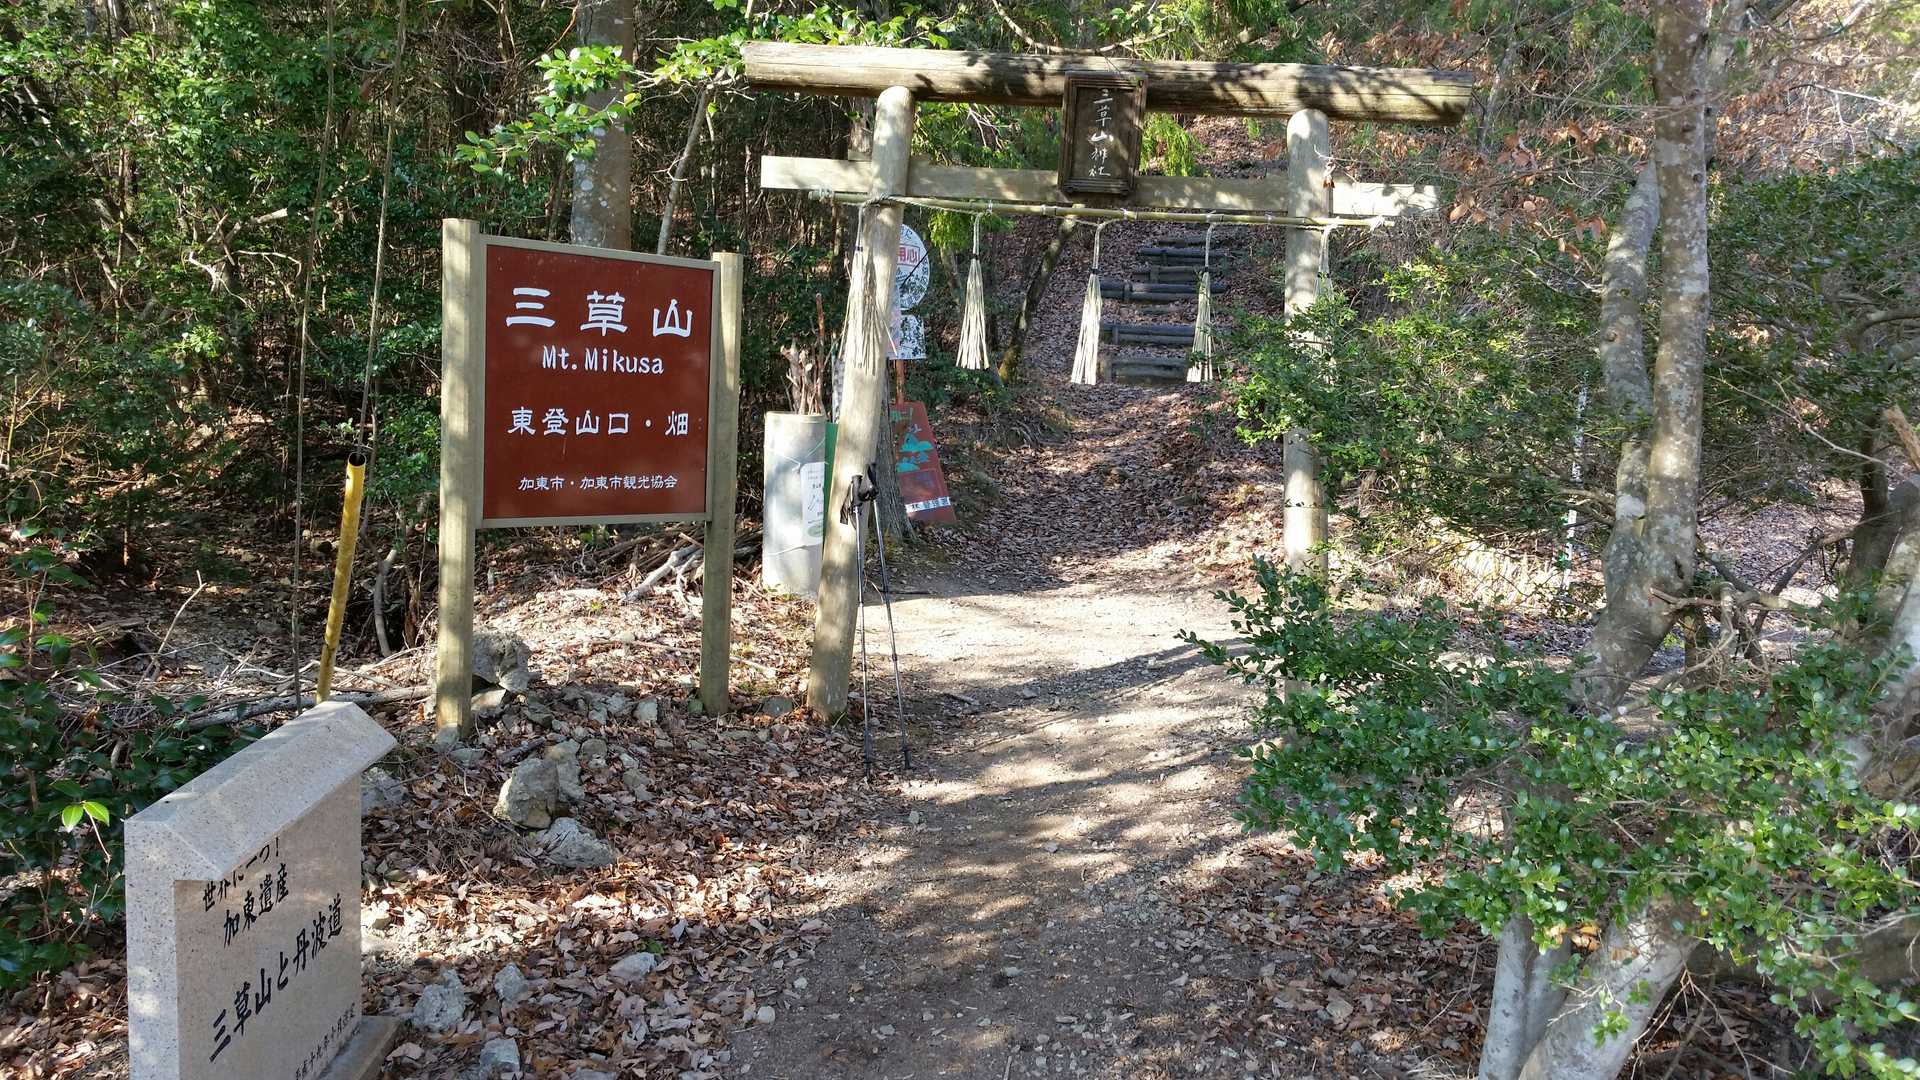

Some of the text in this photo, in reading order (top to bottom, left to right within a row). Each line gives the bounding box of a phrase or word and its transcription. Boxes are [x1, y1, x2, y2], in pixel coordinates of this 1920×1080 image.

[505, 287, 693, 338] 三草山
[507, 406, 689, 437] 東登山口・畑
[517, 475, 679, 491] 加東市・加東市観光協会
[223, 862, 290, 949] 加東遺産
[209, 893, 343, 1063] 三草山と丹波道
